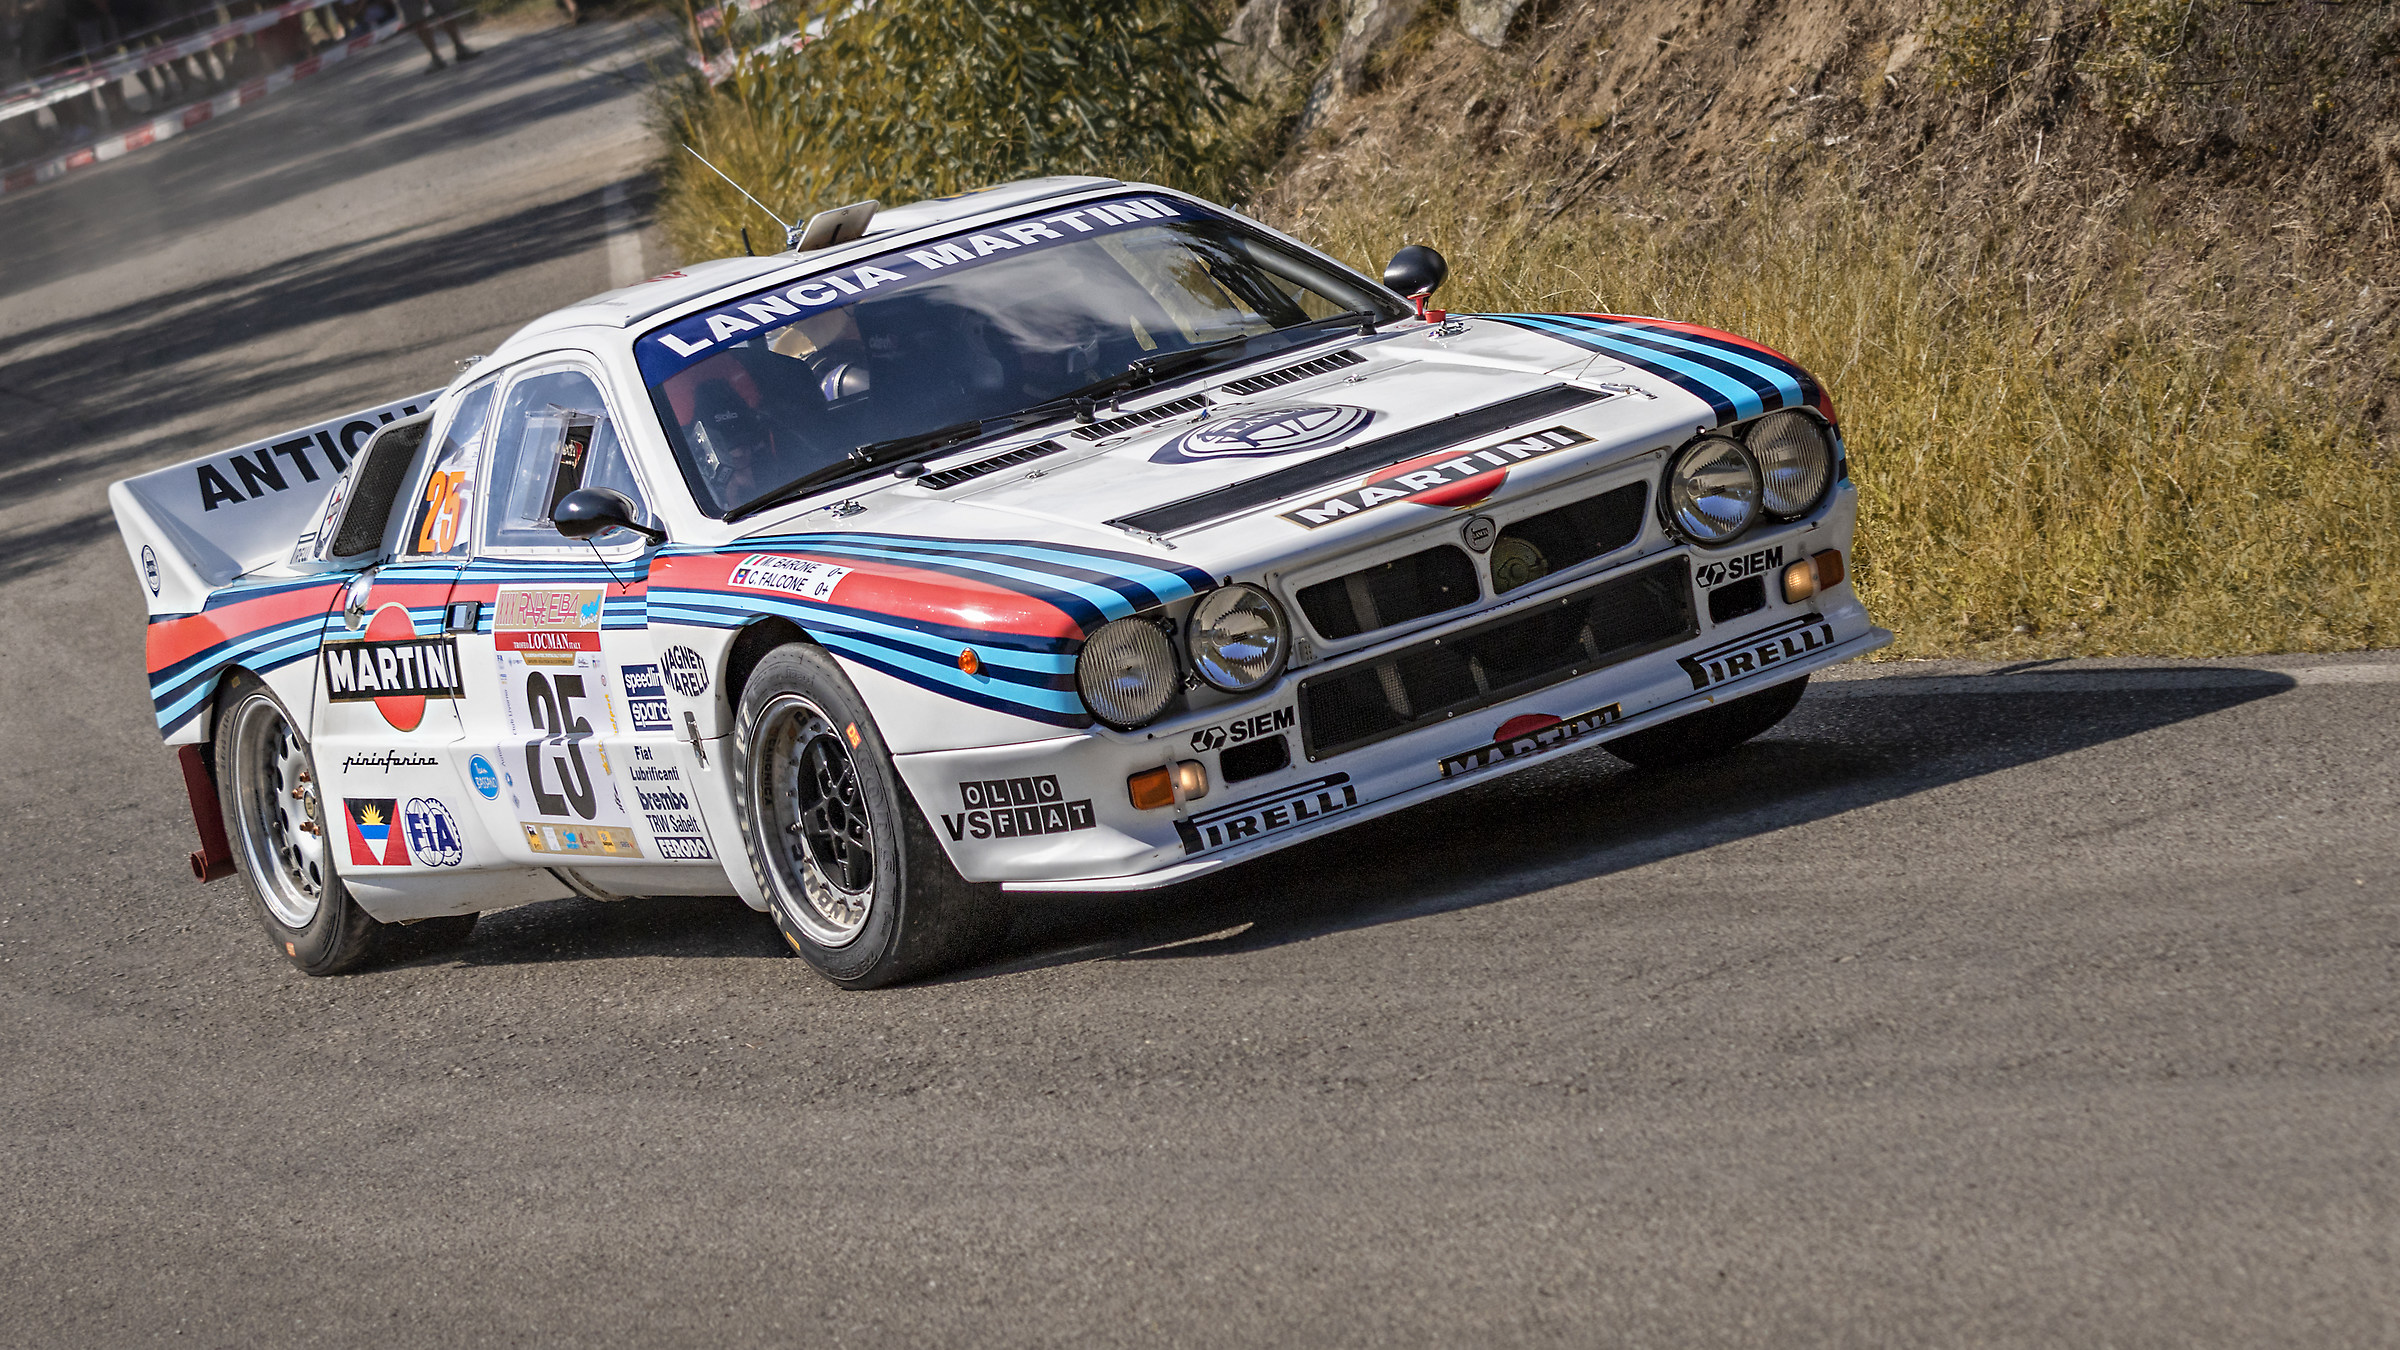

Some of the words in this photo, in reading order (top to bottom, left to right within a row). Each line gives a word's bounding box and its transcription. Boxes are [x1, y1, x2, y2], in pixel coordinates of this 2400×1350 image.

[658, 264, 907, 358] LANCIA
[905, 198, 1182, 271] MARTINI
[196, 399, 438, 512] ANTI
[1295, 431, 1576, 524] MARTINI
[418, 471, 465, 553] 25
[772, 558, 822, 574] BARONE
[1729, 545, 1784, 580] SIEM
[748, 570, 757, 586] C.
[757, 571, 809, 592] FALCONE
[527, 633, 569, 650] LOCMAN
[1676, 612, 1835, 691] PIRELLI
[328, 644, 459, 693] MARTINI
[660, 645, 706, 671] MAGNETI
[664, 671, 710, 698] MARELLI
[632, 702, 672, 728] sparc
[1229, 706, 1296, 743] SIEM
[525, 671, 598, 821] 25
[634, 746, 654, 760] Fiat
[343, 750, 439, 774] pininfarina
[630, 766, 680, 781] Lubrificanti
[635, 786, 690, 811] brembo
[964, 778, 1058, 807] OLIO
[646, 814, 672, 833] TRW
[669, 814, 701, 833] Sabelt
[1173, 771, 1359, 856] PIRELLI
[657, 838, 709, 858] FERODO
